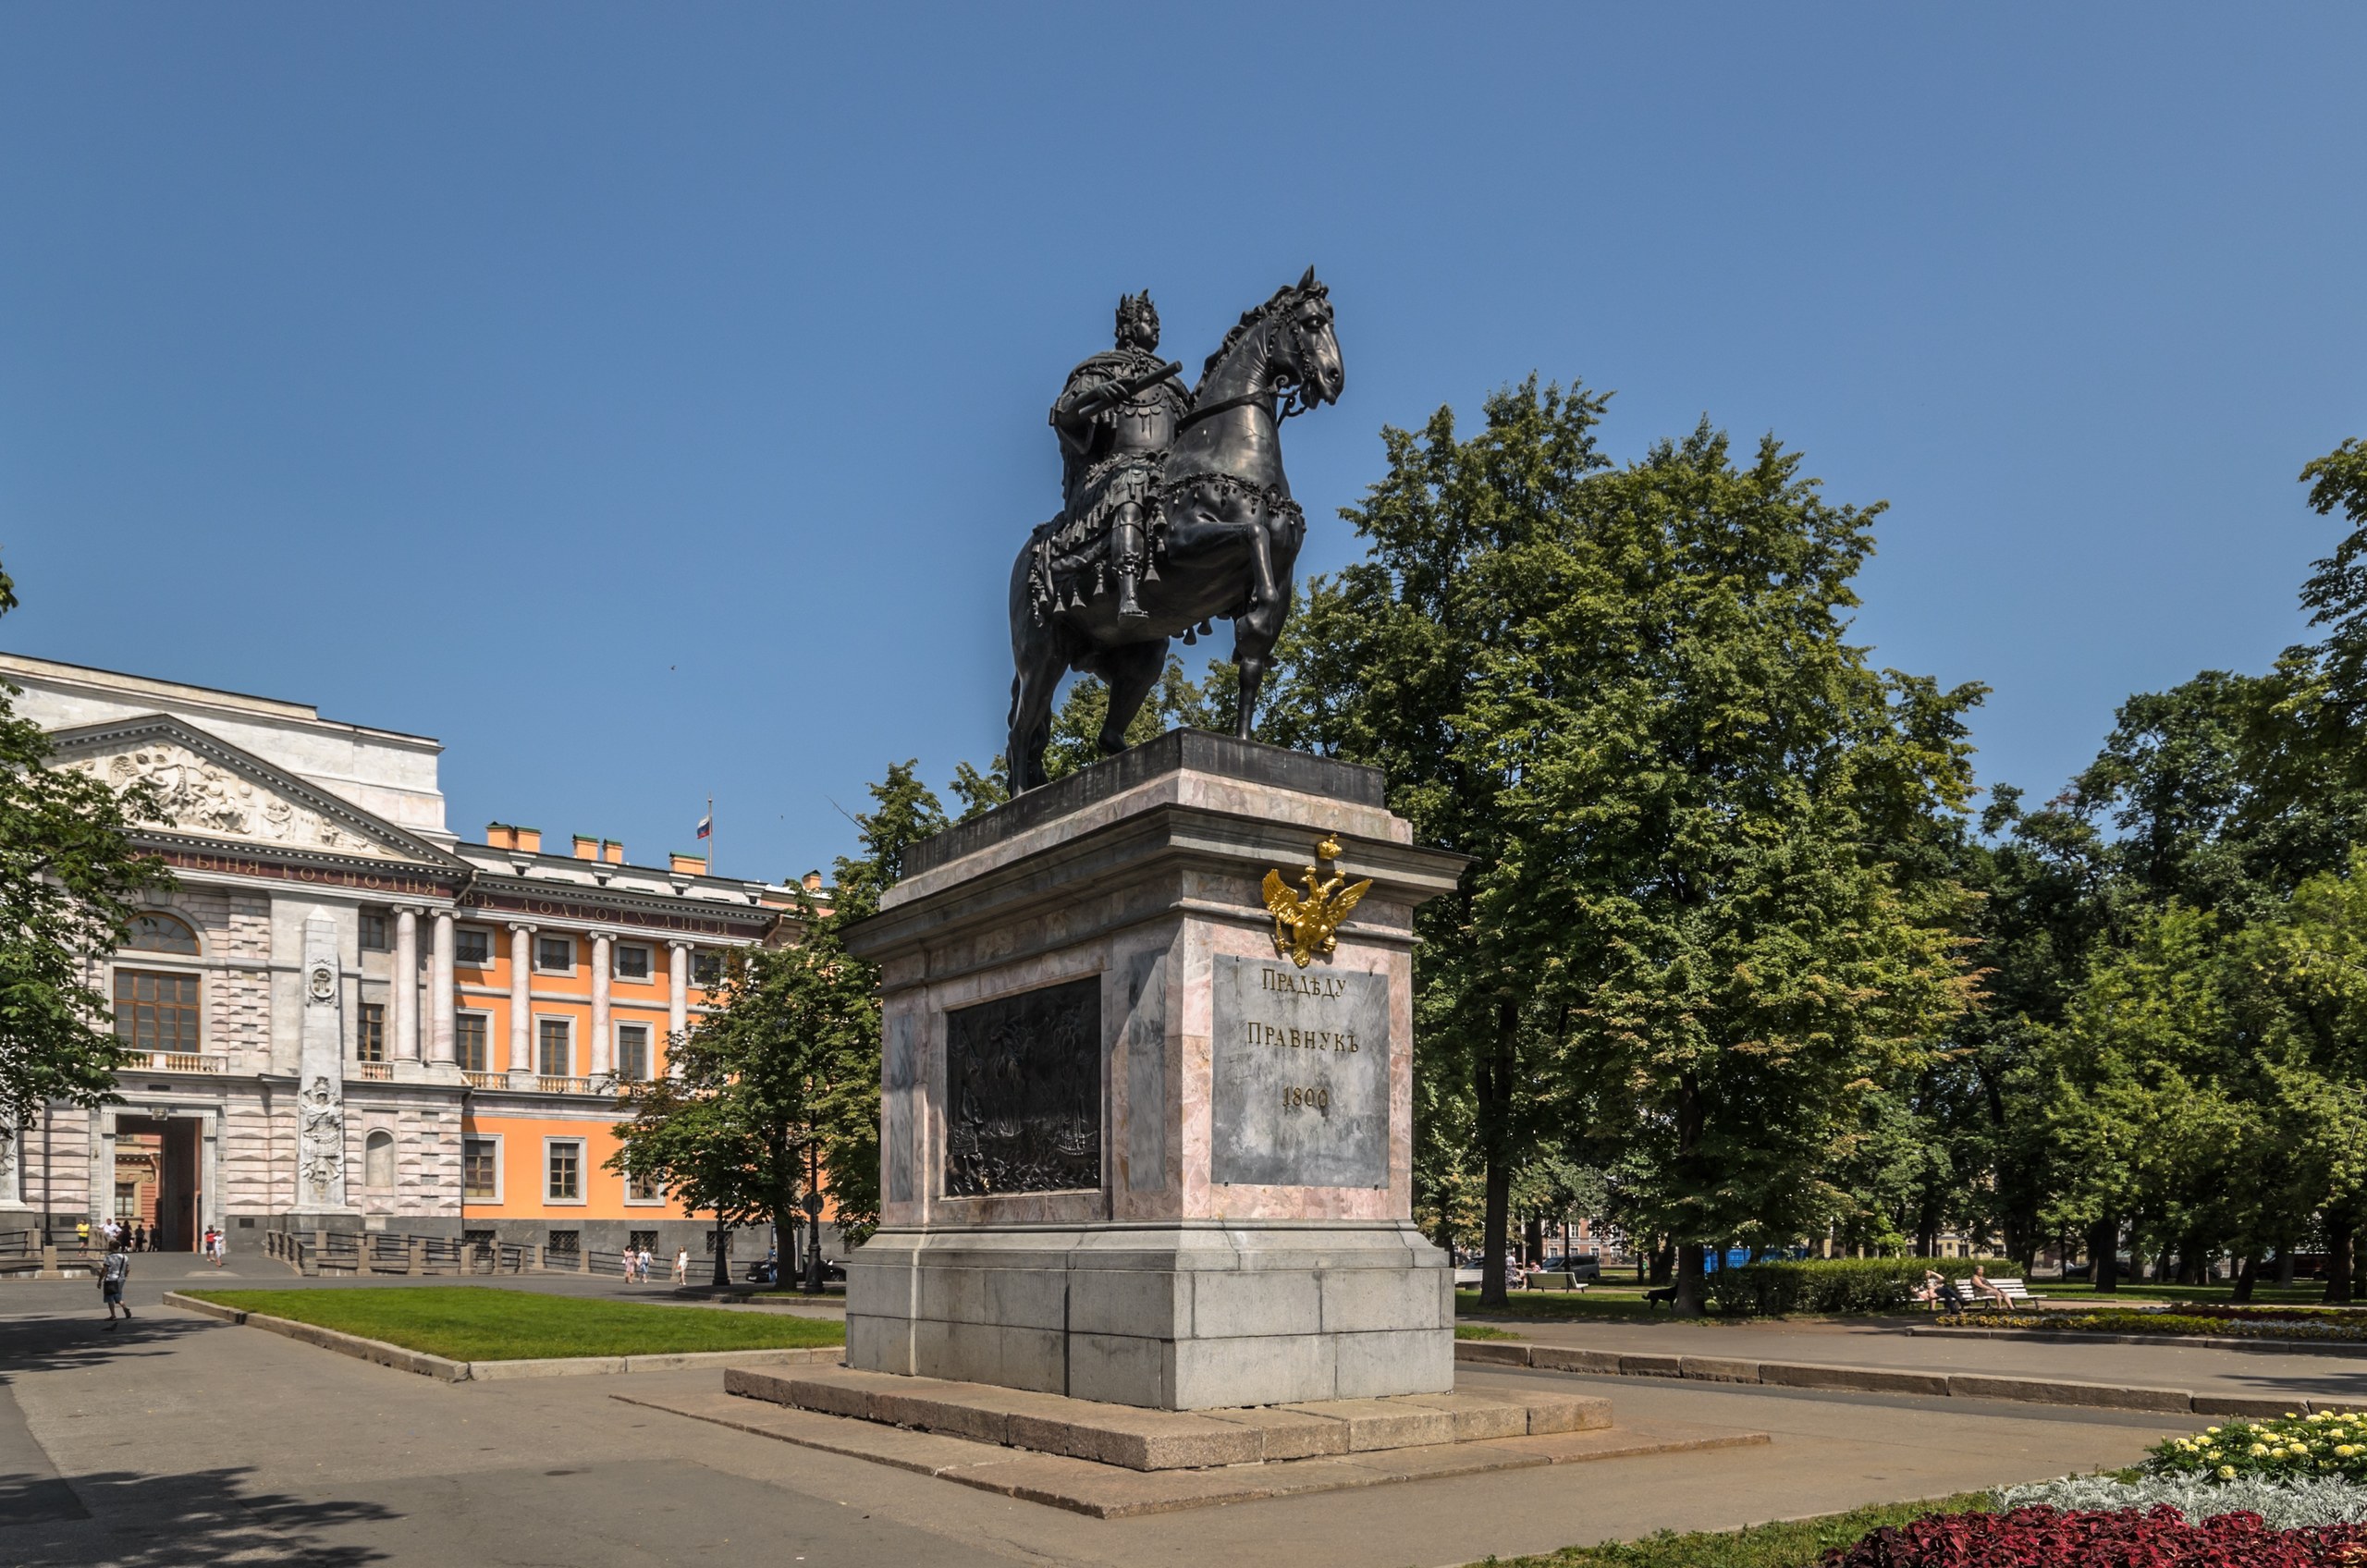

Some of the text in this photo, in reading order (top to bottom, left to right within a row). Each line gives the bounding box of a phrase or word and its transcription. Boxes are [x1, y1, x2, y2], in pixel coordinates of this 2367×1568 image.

[463, 892, 495, 909] ВЪ
[518, 899, 649, 925] ДОЛГОТУ
[1247, 1022, 1358, 1052] ПРАВНУКЪ
[1282, 1086, 1328, 1109] 1800
